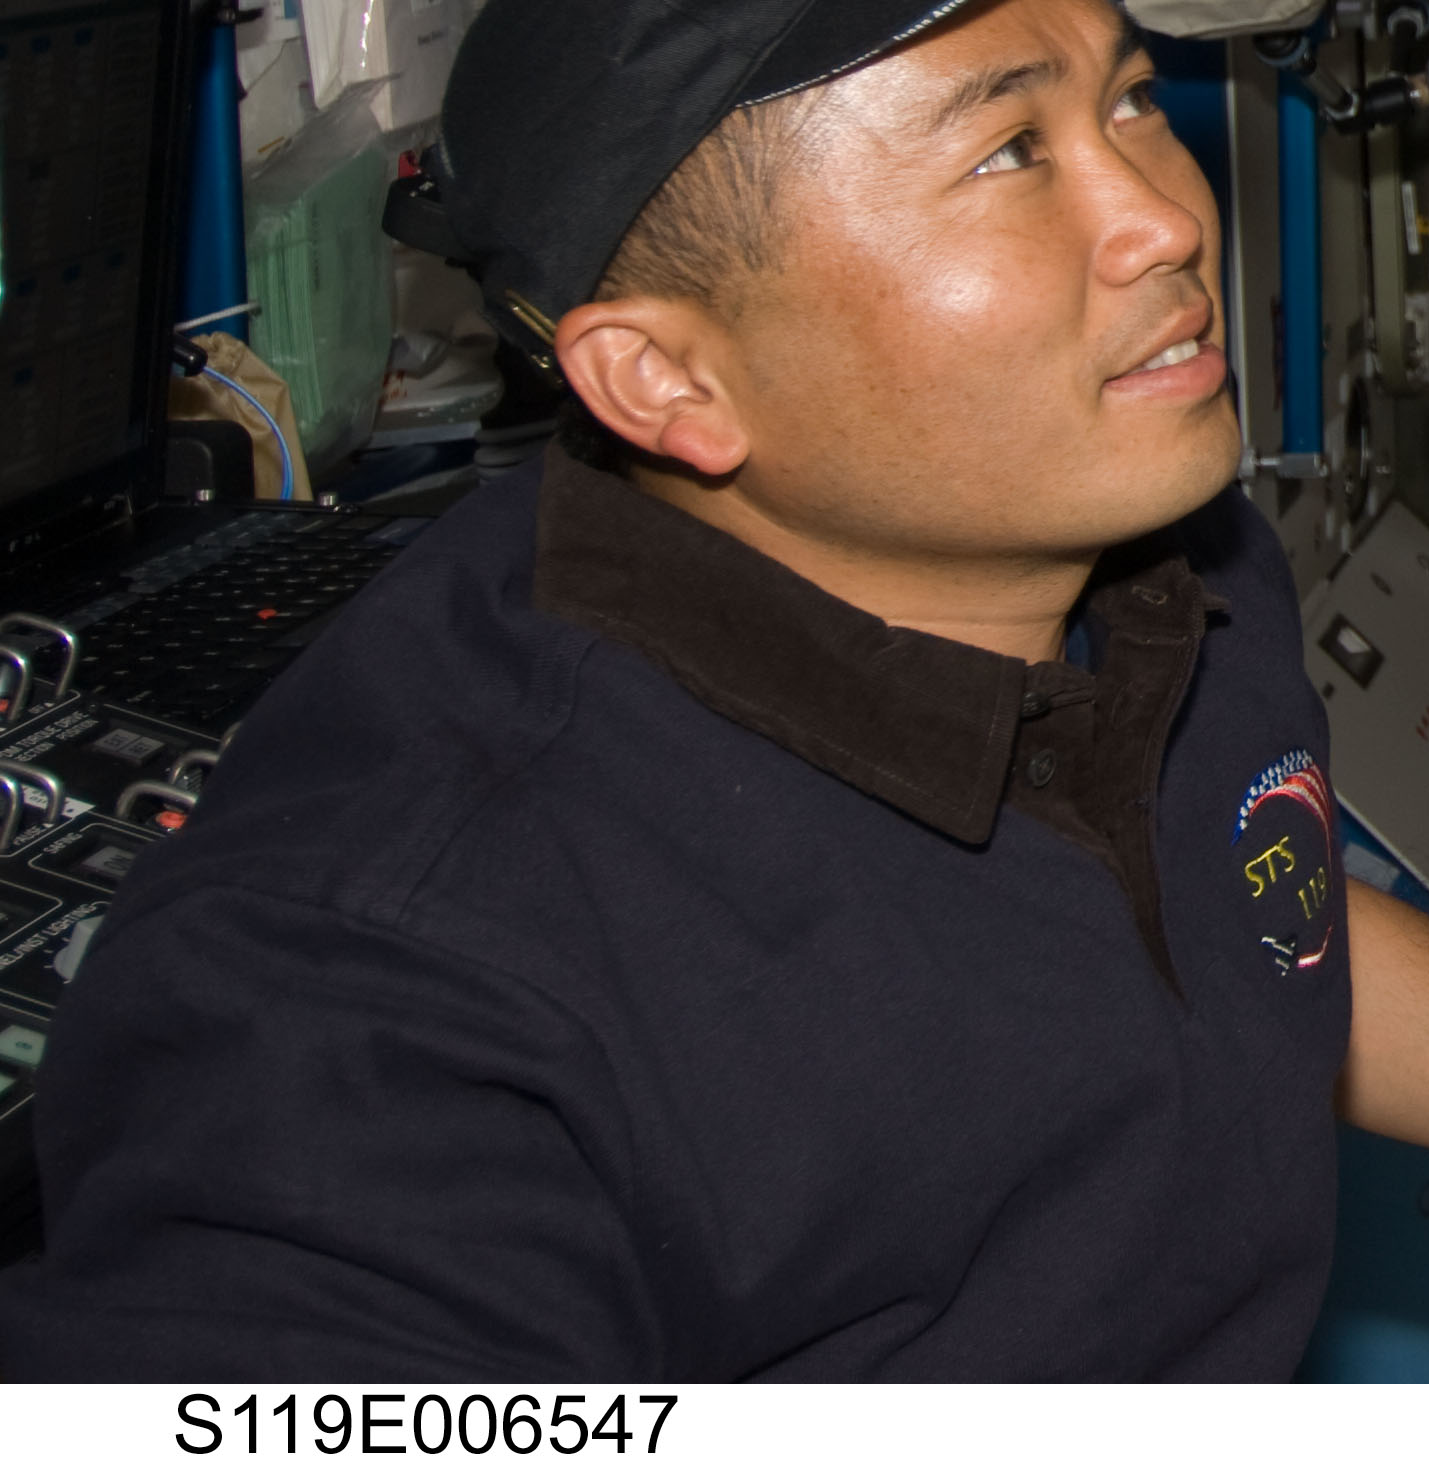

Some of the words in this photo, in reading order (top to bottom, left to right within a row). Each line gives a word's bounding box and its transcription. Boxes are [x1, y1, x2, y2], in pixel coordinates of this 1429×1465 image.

[1244, 835, 1297, 898] STS
[42, 902, 98, 937] LIGHTING
[1298, 867, 1329, 921] 119
